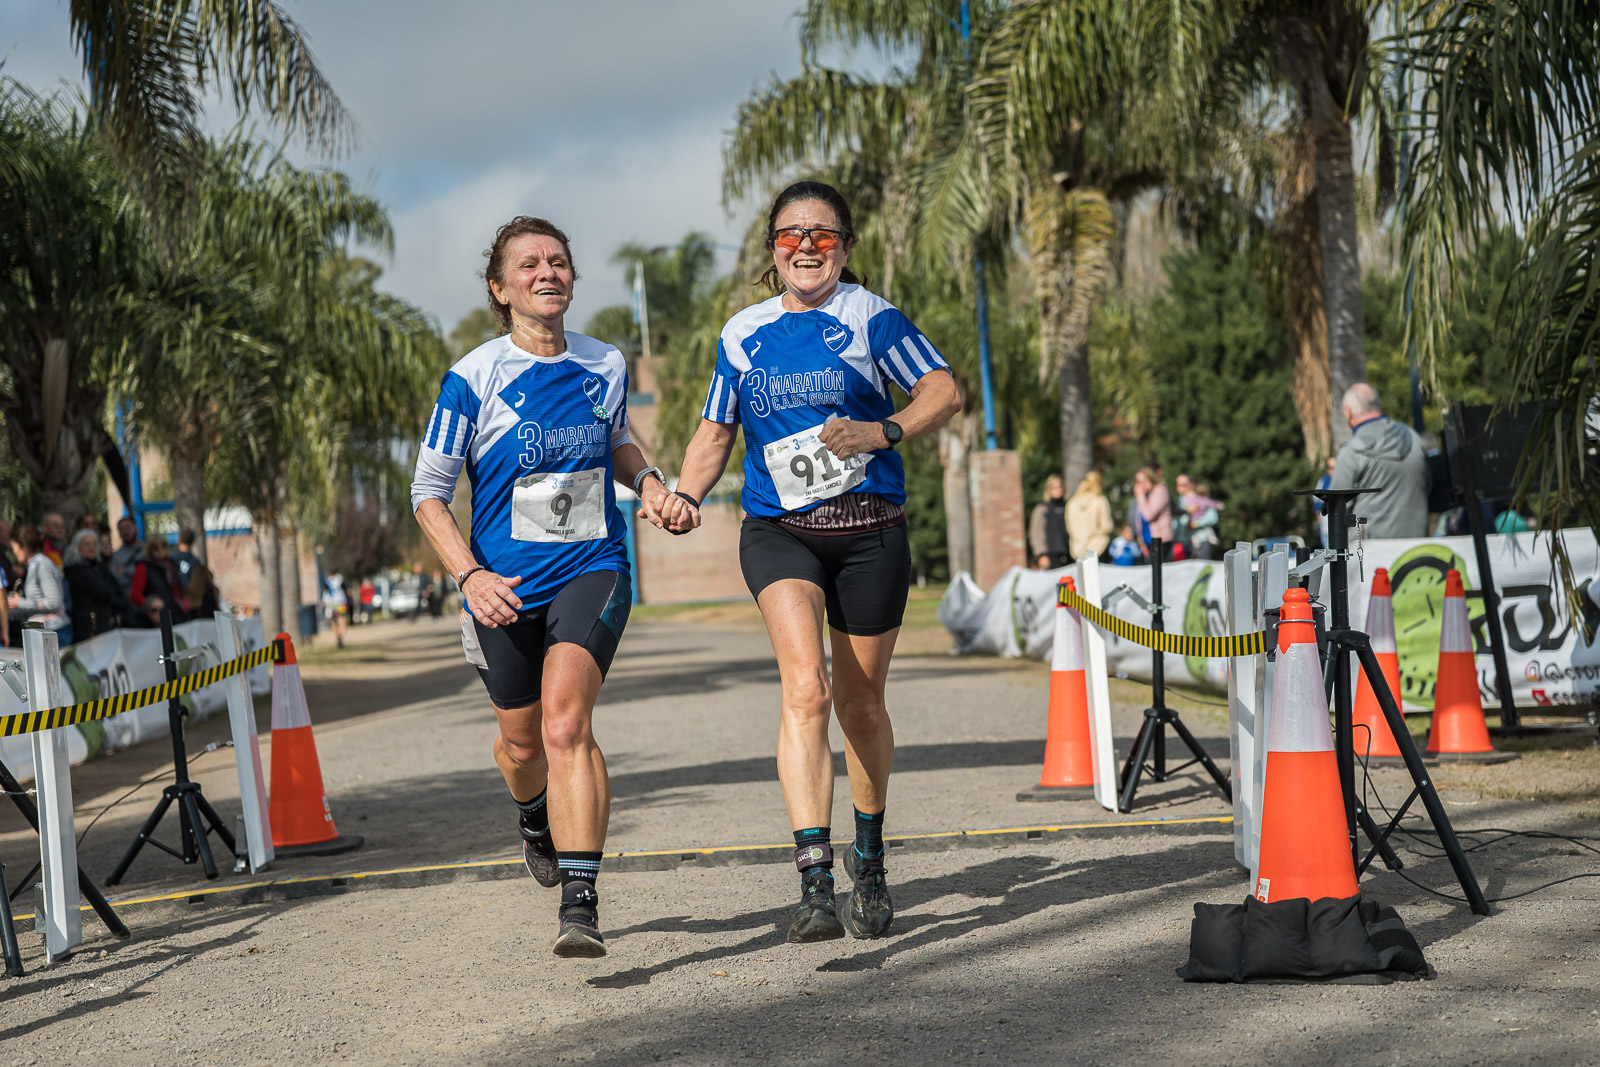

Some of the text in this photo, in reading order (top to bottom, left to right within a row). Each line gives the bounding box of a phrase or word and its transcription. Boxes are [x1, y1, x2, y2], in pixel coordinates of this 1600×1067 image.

[746, 368, 771, 418] 3
[769, 366, 845, 397] MARATÓN
[517, 421, 543, 469] 3
[544, 420, 606, 449] MARATÓN
[790, 445, 842, 487] 91
[550, 493, 573, 527] 9
